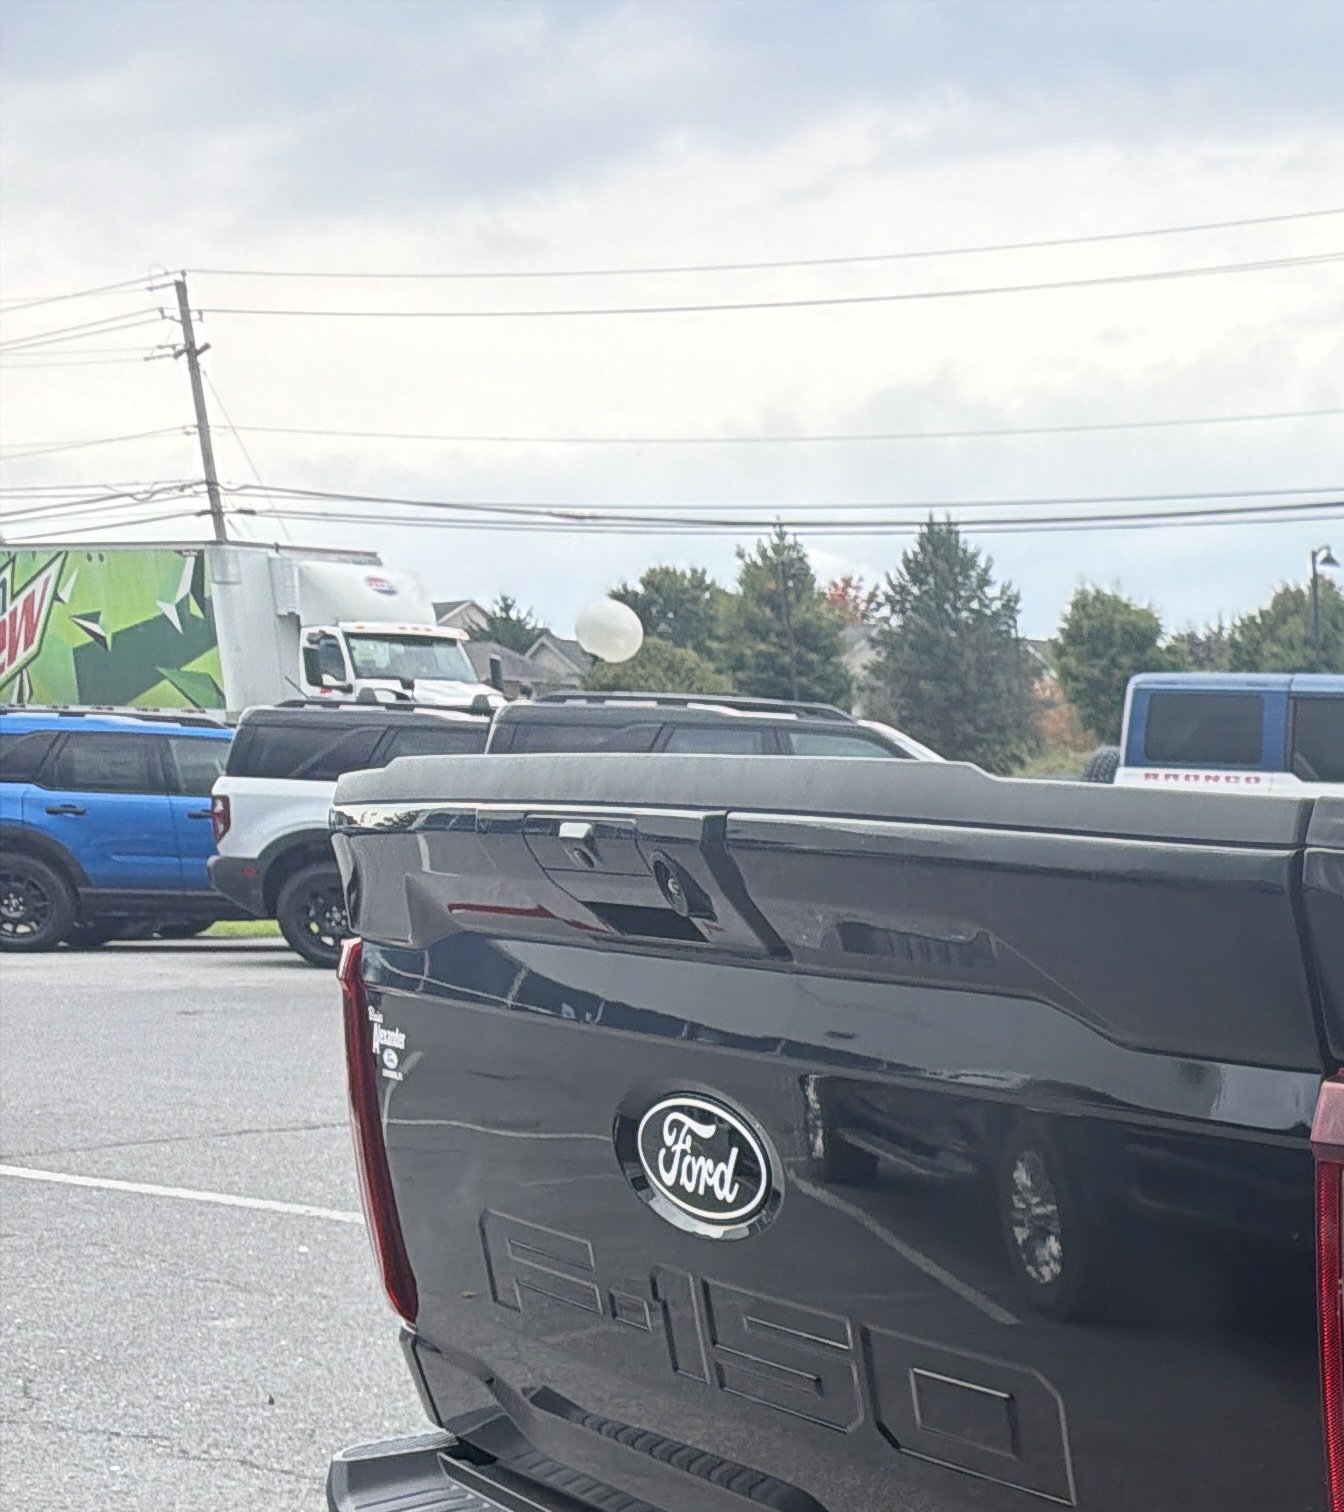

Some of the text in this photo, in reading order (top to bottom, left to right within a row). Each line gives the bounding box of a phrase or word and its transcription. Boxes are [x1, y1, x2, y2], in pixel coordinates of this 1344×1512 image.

[1144, 772, 1261, 785] BRONCO
[658, 1111, 740, 1203] Ford
[479, 1208, 1076, 1506] F-150
